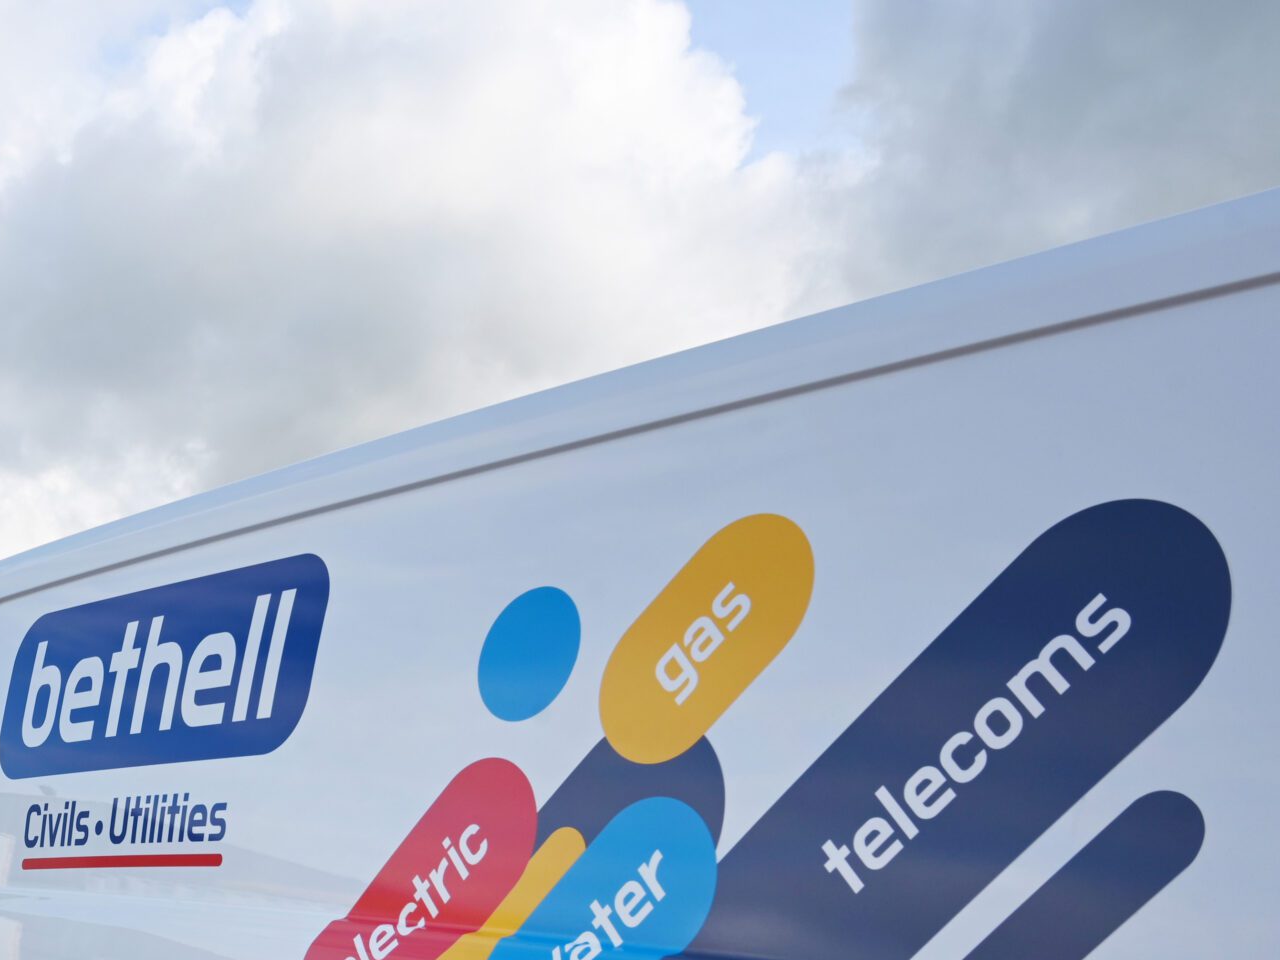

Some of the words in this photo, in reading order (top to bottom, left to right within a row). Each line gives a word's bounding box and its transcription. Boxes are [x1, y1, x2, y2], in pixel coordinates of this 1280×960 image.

[21, 588, 297, 748] bethell
[654, 581, 752, 706] gas
[821, 592, 1133, 894] telecoms
[108, 793, 228, 845] Utilities
